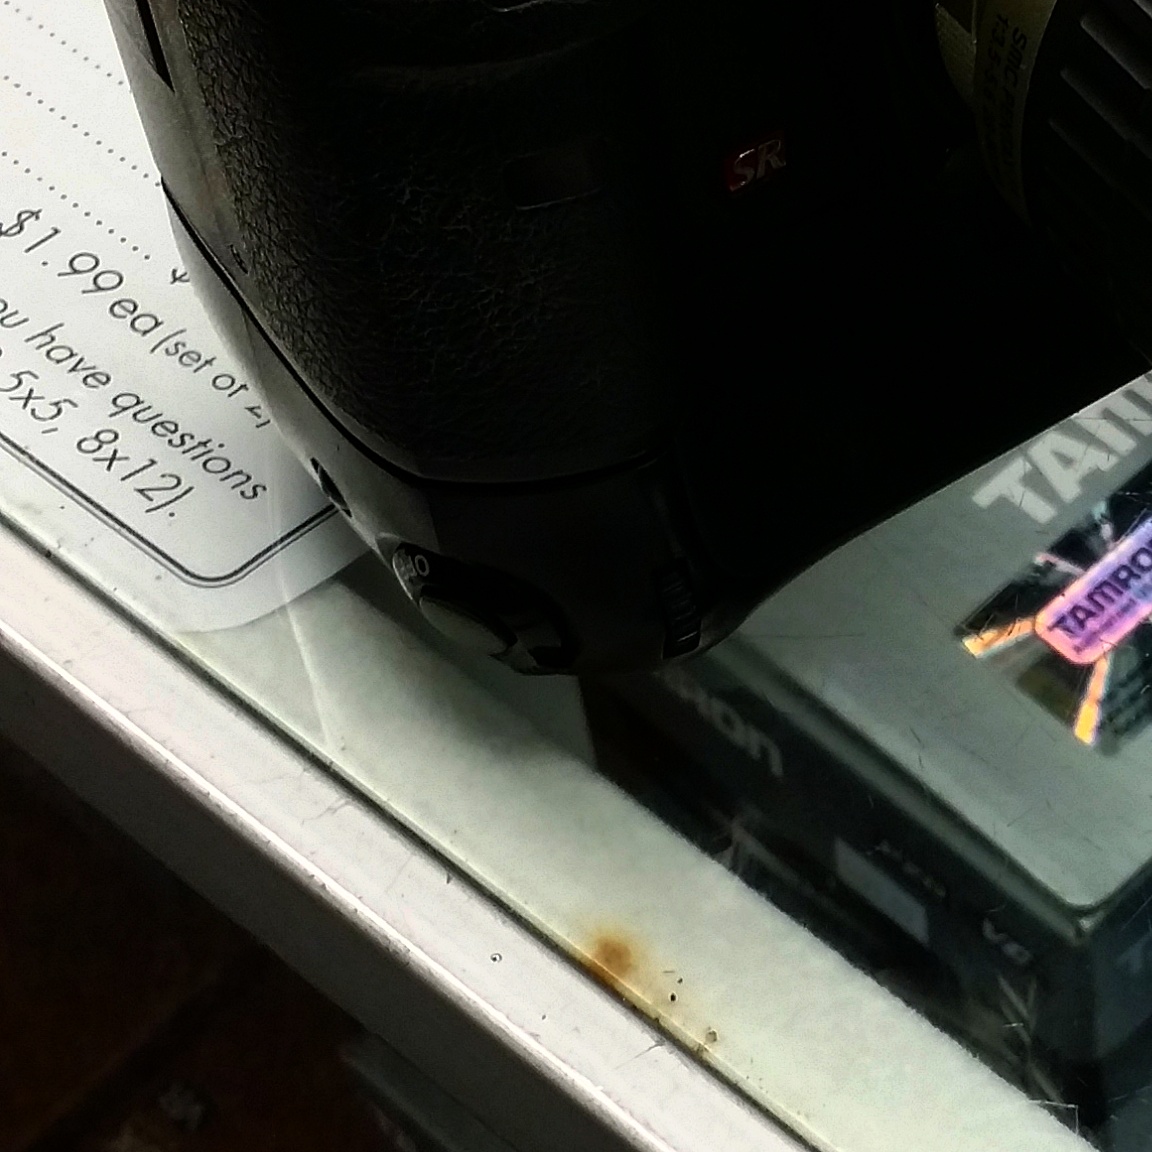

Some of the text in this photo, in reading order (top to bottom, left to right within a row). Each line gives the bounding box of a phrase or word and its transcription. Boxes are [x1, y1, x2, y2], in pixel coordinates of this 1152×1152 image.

[728, 137, 787, 192] SR
[24, 323, 112, 388] have
[108, 392, 267, 500] questions
[76, 428, 195, 518] 8x12).
